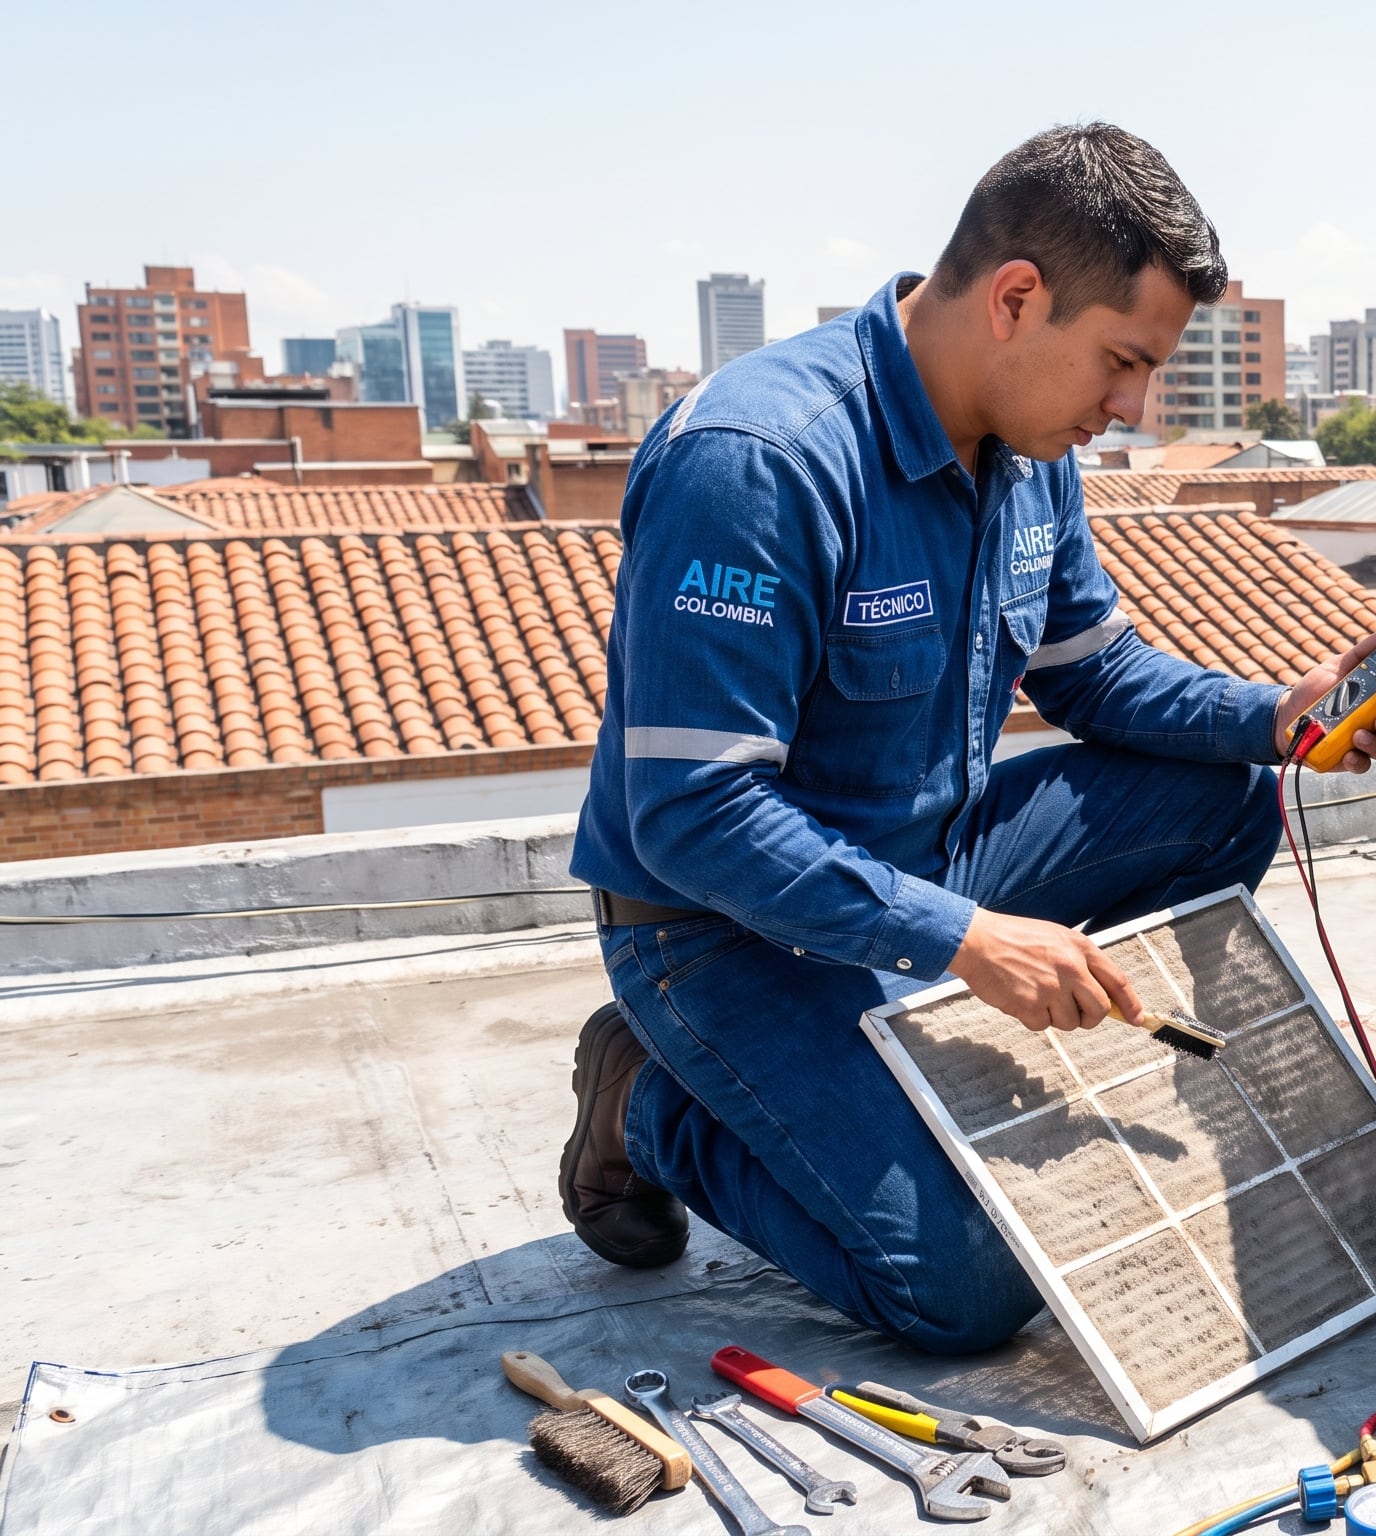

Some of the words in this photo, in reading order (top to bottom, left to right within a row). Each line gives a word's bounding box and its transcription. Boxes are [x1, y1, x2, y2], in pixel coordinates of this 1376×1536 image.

[1011, 523, 1054, 561] AIRE
[678, 559, 781, 609] AIRE
[674, 595, 774, 627] COLOMBIA
[858, 592, 924, 620] TÉCNICO
